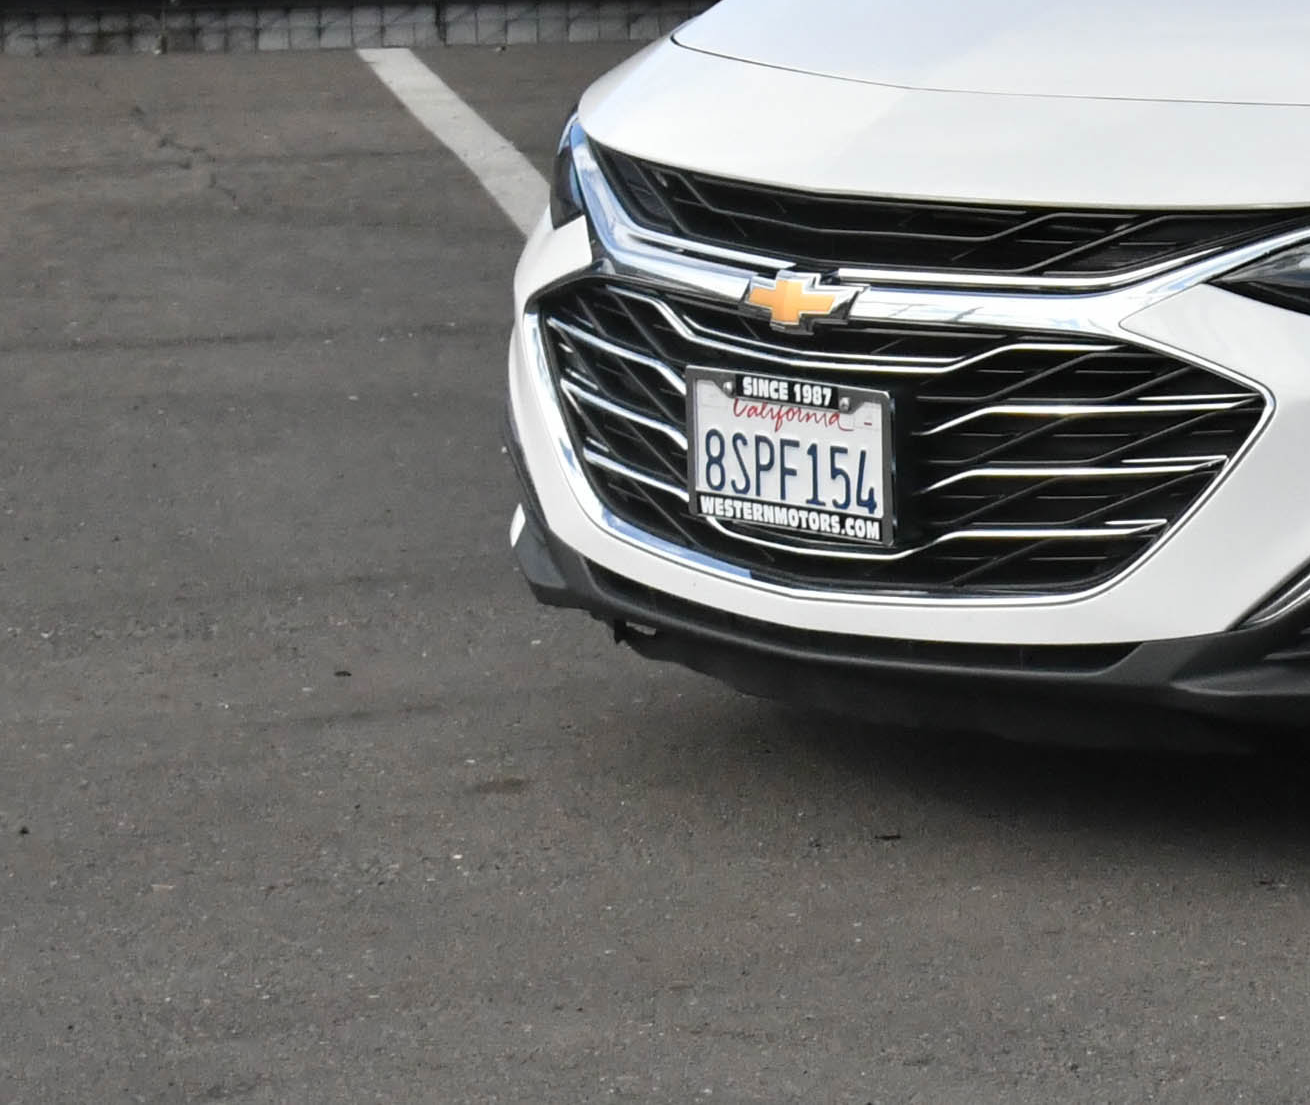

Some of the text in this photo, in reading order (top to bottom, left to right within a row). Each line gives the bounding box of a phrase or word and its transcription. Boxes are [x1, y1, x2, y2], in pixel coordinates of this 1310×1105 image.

[742, 376, 832, 407] SINCE 1987
[732, 398, 855, 433] California
[705, 428, 878, 515] 8SPF154
[700, 495, 881, 540] WESTERNMOTORS.COM
